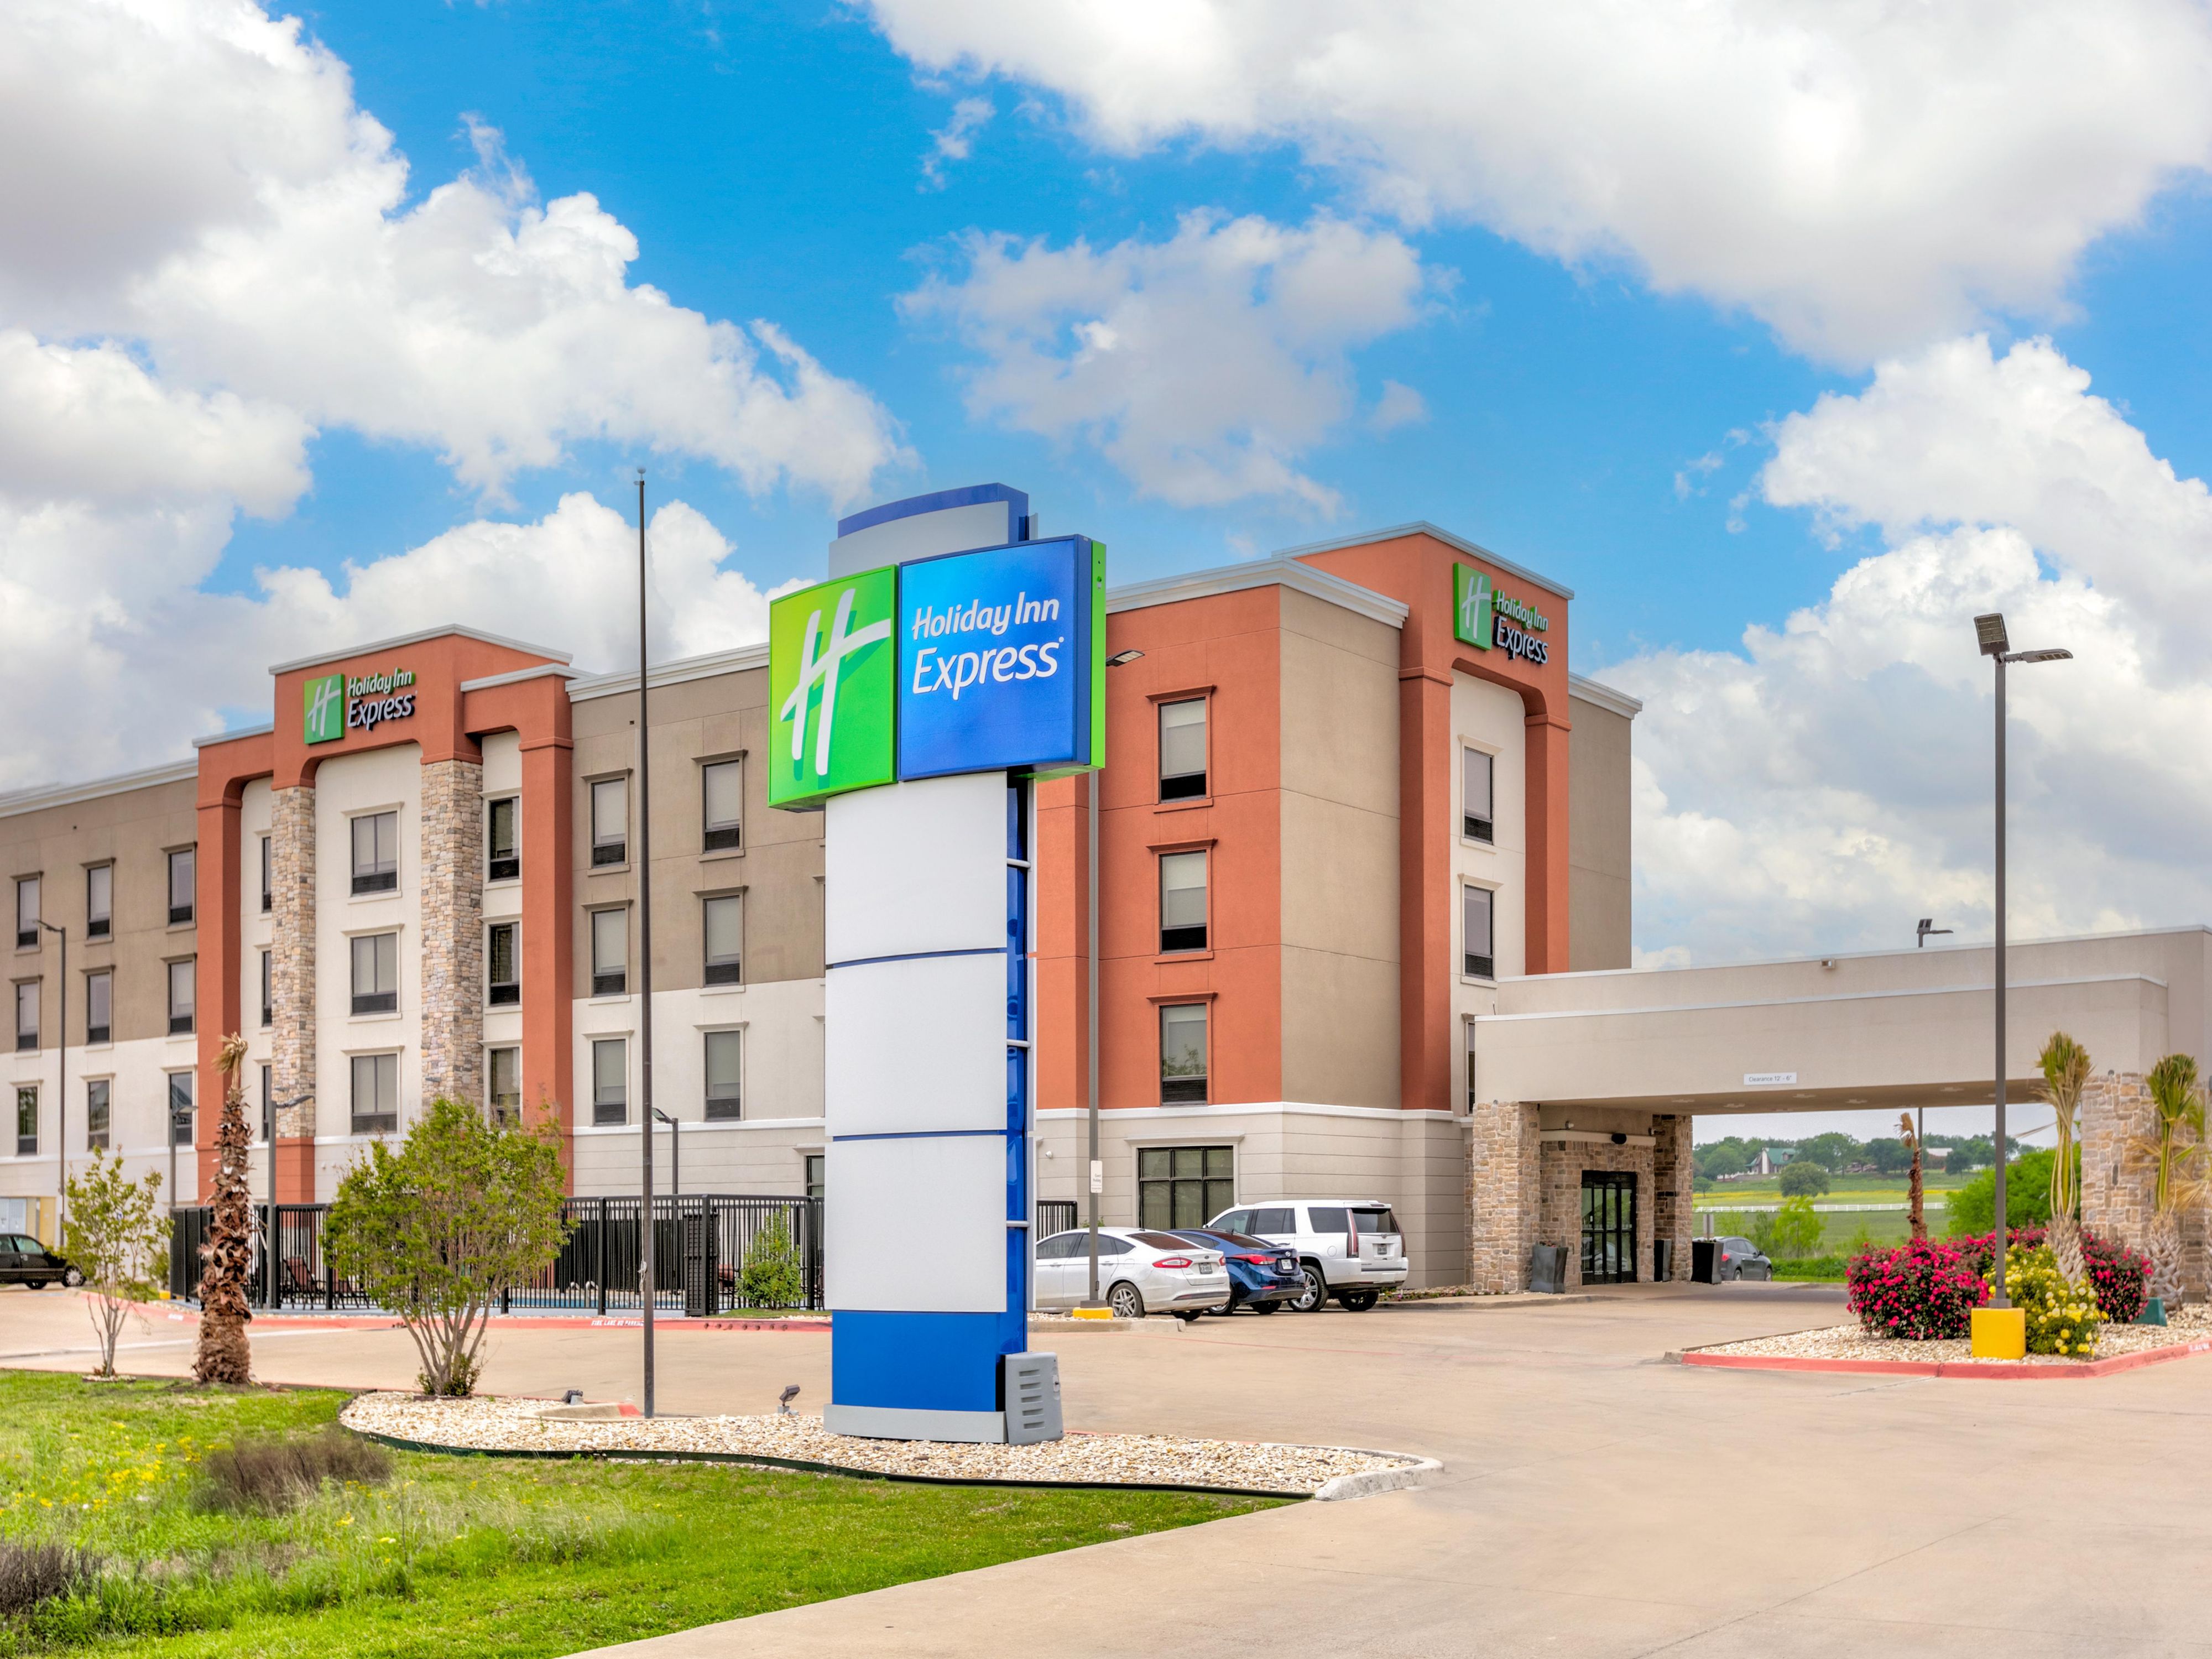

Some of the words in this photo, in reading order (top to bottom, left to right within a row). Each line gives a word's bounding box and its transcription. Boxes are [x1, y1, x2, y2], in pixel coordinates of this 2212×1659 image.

[912, 599, 1011, 641] Holiday
[1015, 592, 1059, 625] Inn
[1497, 589, 1533, 629] Holiday
[1533, 606, 1548, 631] Inn
[1496, 615, 1548, 664] Express
[347, 672, 393, 697] Holiday
[393, 667, 412, 687] Inn
[912, 640, 1061, 701] Express
[347, 694, 413, 731] Express
